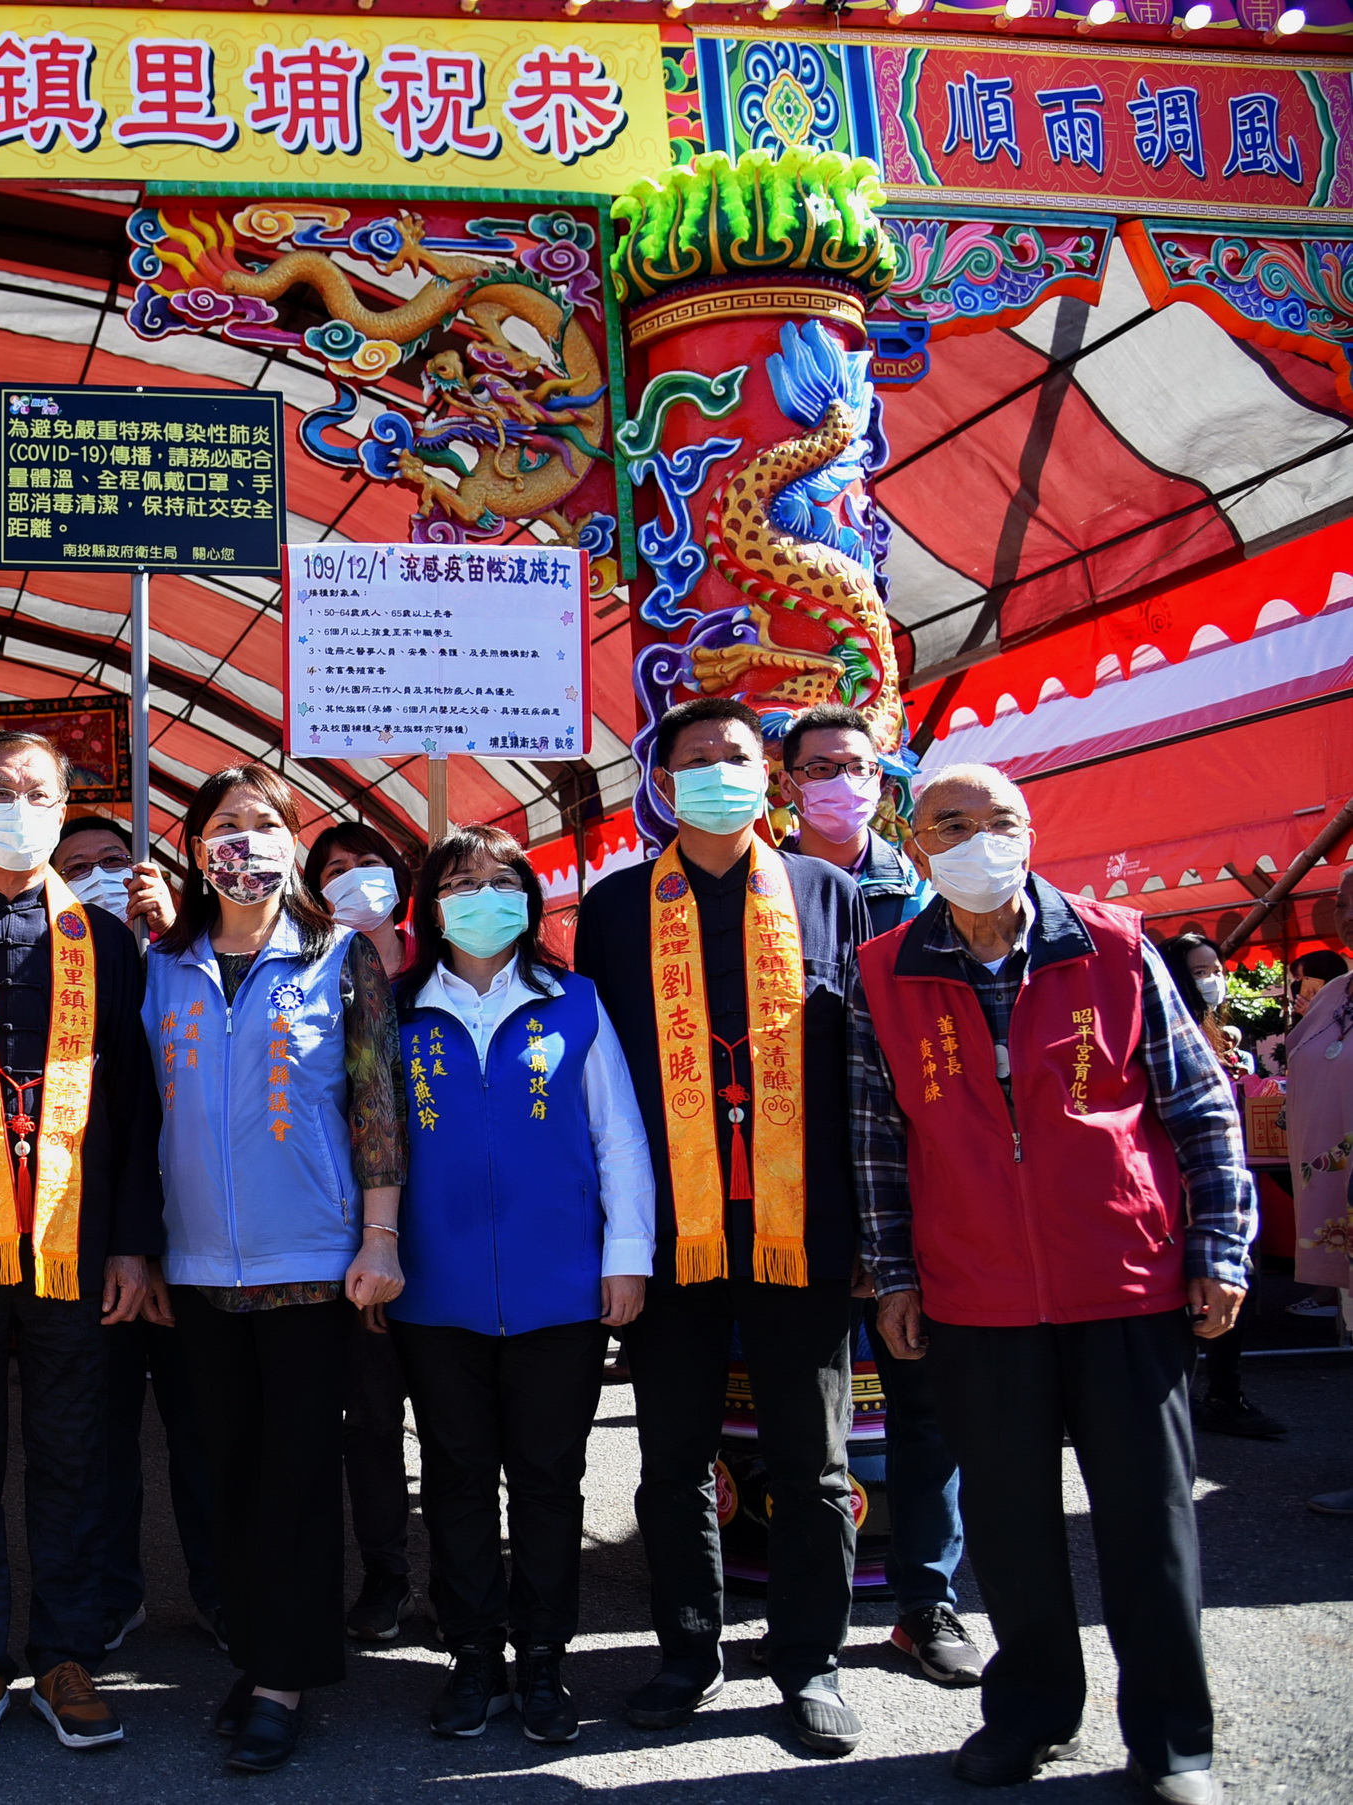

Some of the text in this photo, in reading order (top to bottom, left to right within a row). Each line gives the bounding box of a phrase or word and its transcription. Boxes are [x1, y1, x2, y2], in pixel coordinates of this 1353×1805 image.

[942, 69, 1303, 184] 風調雨順
[7, 418, 272, 446] 為避免嚴重特殊傳染性肺炎
[7, 492, 274, 520] 部消毒清潔，保持社交安全
[62, 543, 235, 561] 南投縣政府衛生局 關心您
[304, 550, 387, 584] 109/12/1
[184, 1000, 205, 1069] 縣議員
[429, 1026, 448, 1078] 民政處
[936, 1014, 963, 1076] 董事長
[268, 1014, 293, 1142] 南投縣議會
[525, 1017, 549, 1121] 南投縣政府
